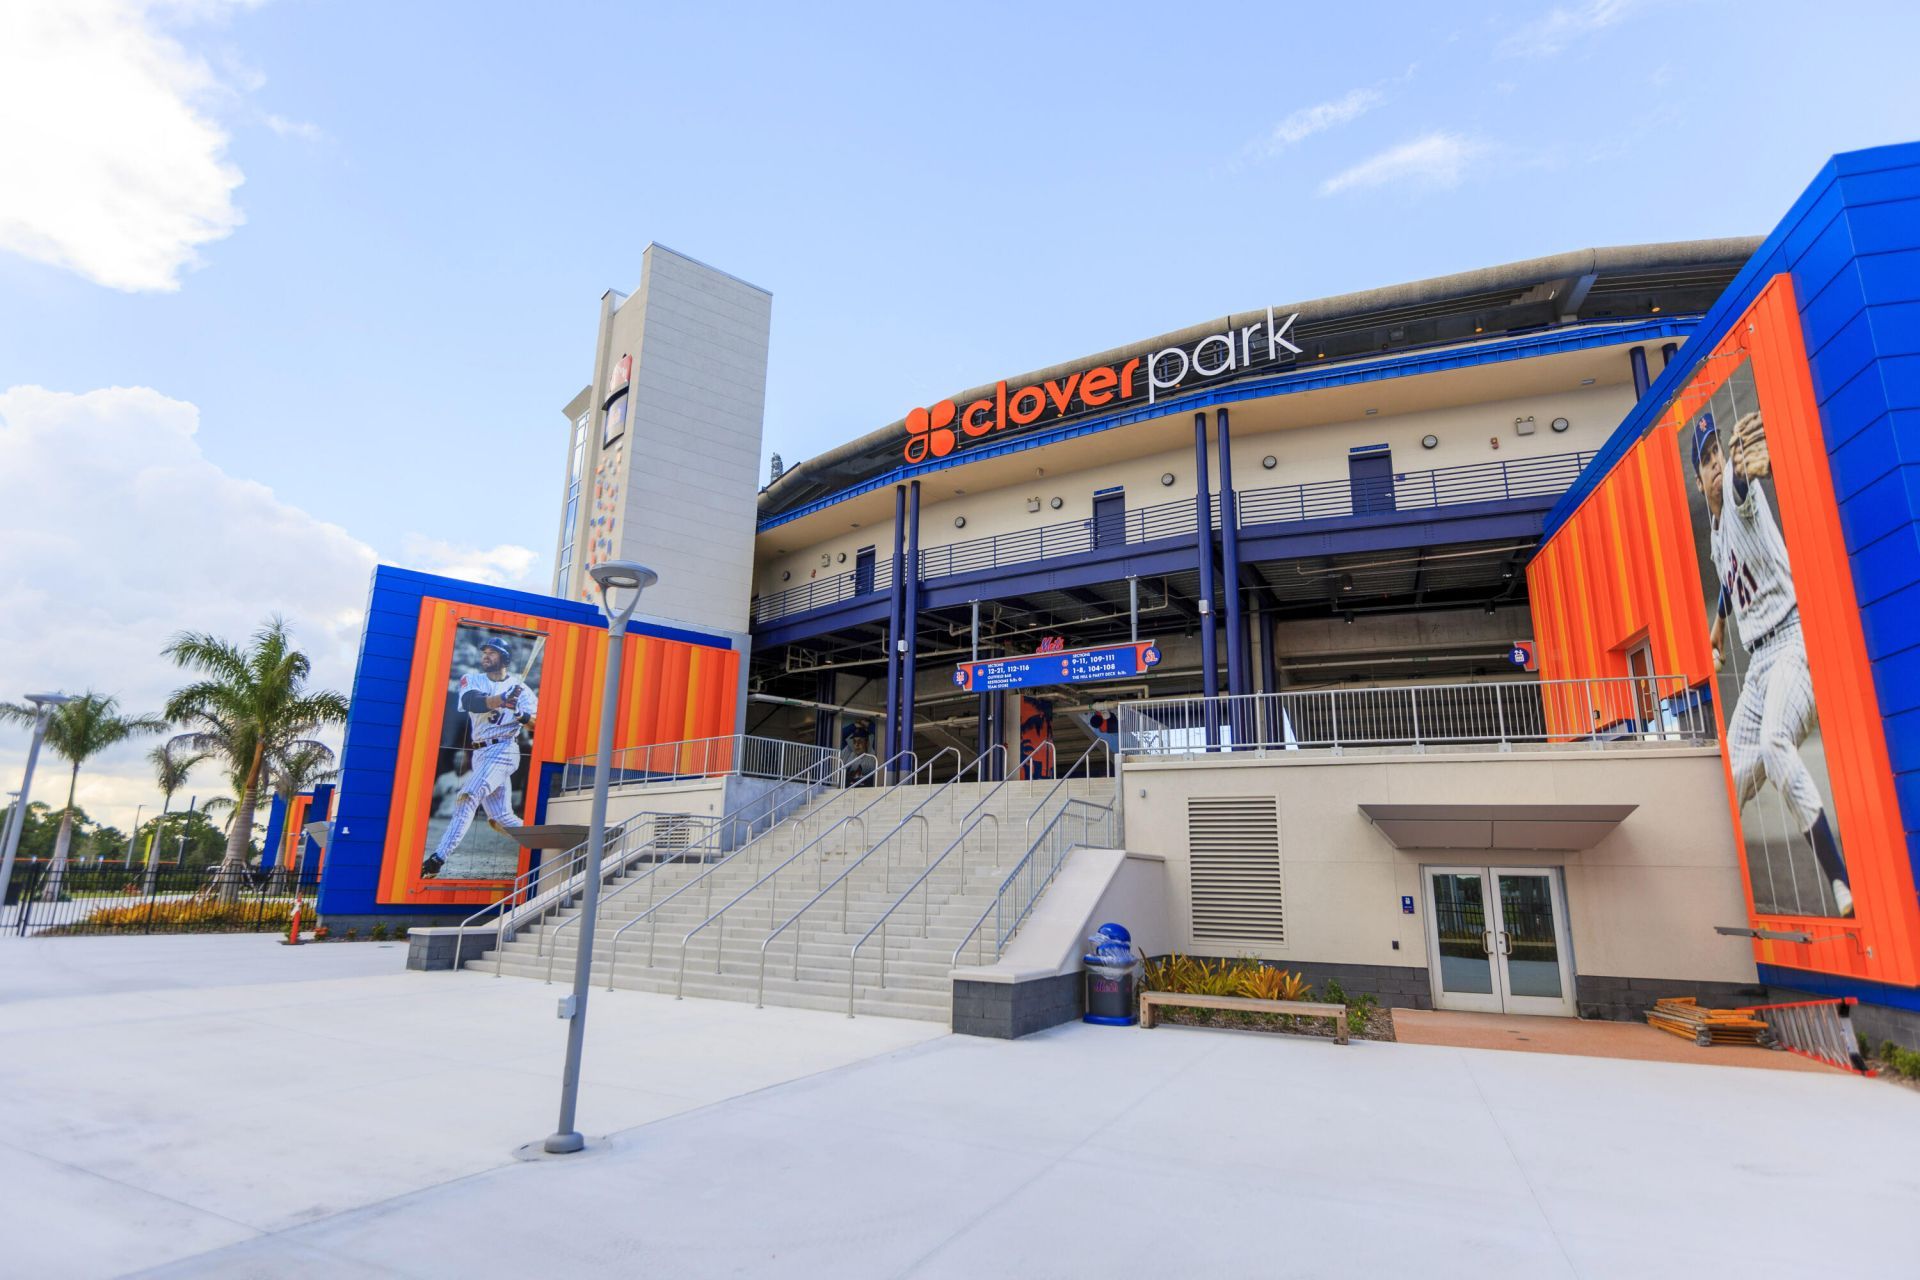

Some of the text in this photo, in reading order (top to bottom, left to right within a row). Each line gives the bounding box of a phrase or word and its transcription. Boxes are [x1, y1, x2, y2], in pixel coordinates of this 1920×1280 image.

[962, 305, 1303, 437] clover park
[1737, 561, 1758, 609] 41
[1036, 636, 1064, 652] Mets
[1090, 654, 1115, 663] 109-111
[1007, 665, 1030, 673] 112-116
[1088, 664, 1116, 672] 104-108
[488, 710, 506, 726] 31
